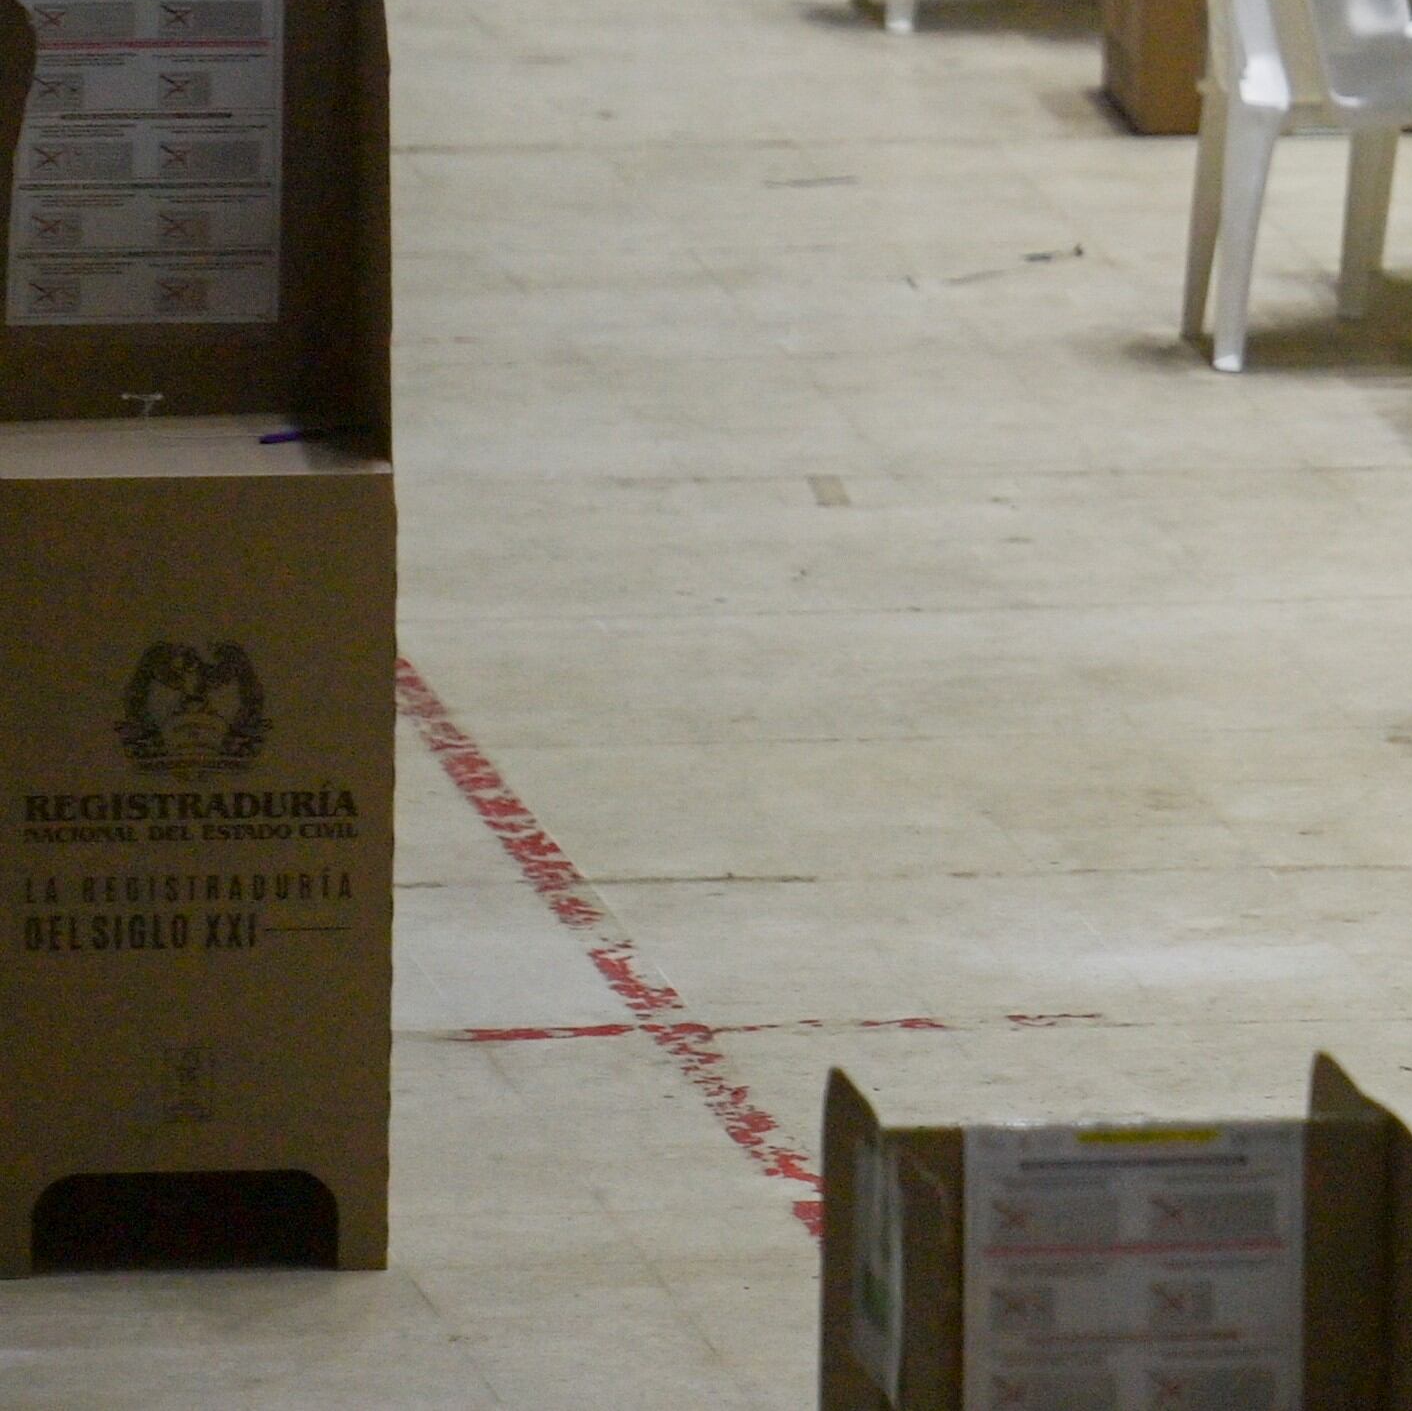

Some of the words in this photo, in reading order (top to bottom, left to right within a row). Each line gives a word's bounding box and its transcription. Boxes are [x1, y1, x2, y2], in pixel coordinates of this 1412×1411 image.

[23, 782, 358, 821] REGISTRADURÍA
[24, 877, 58, 903] LA
[82, 867, 353, 902] REGISTRADURÍA
[24, 914, 82, 950] DEL
[91, 914, 188, 950] SIGLO
[205, 913, 257, 947] XXI
